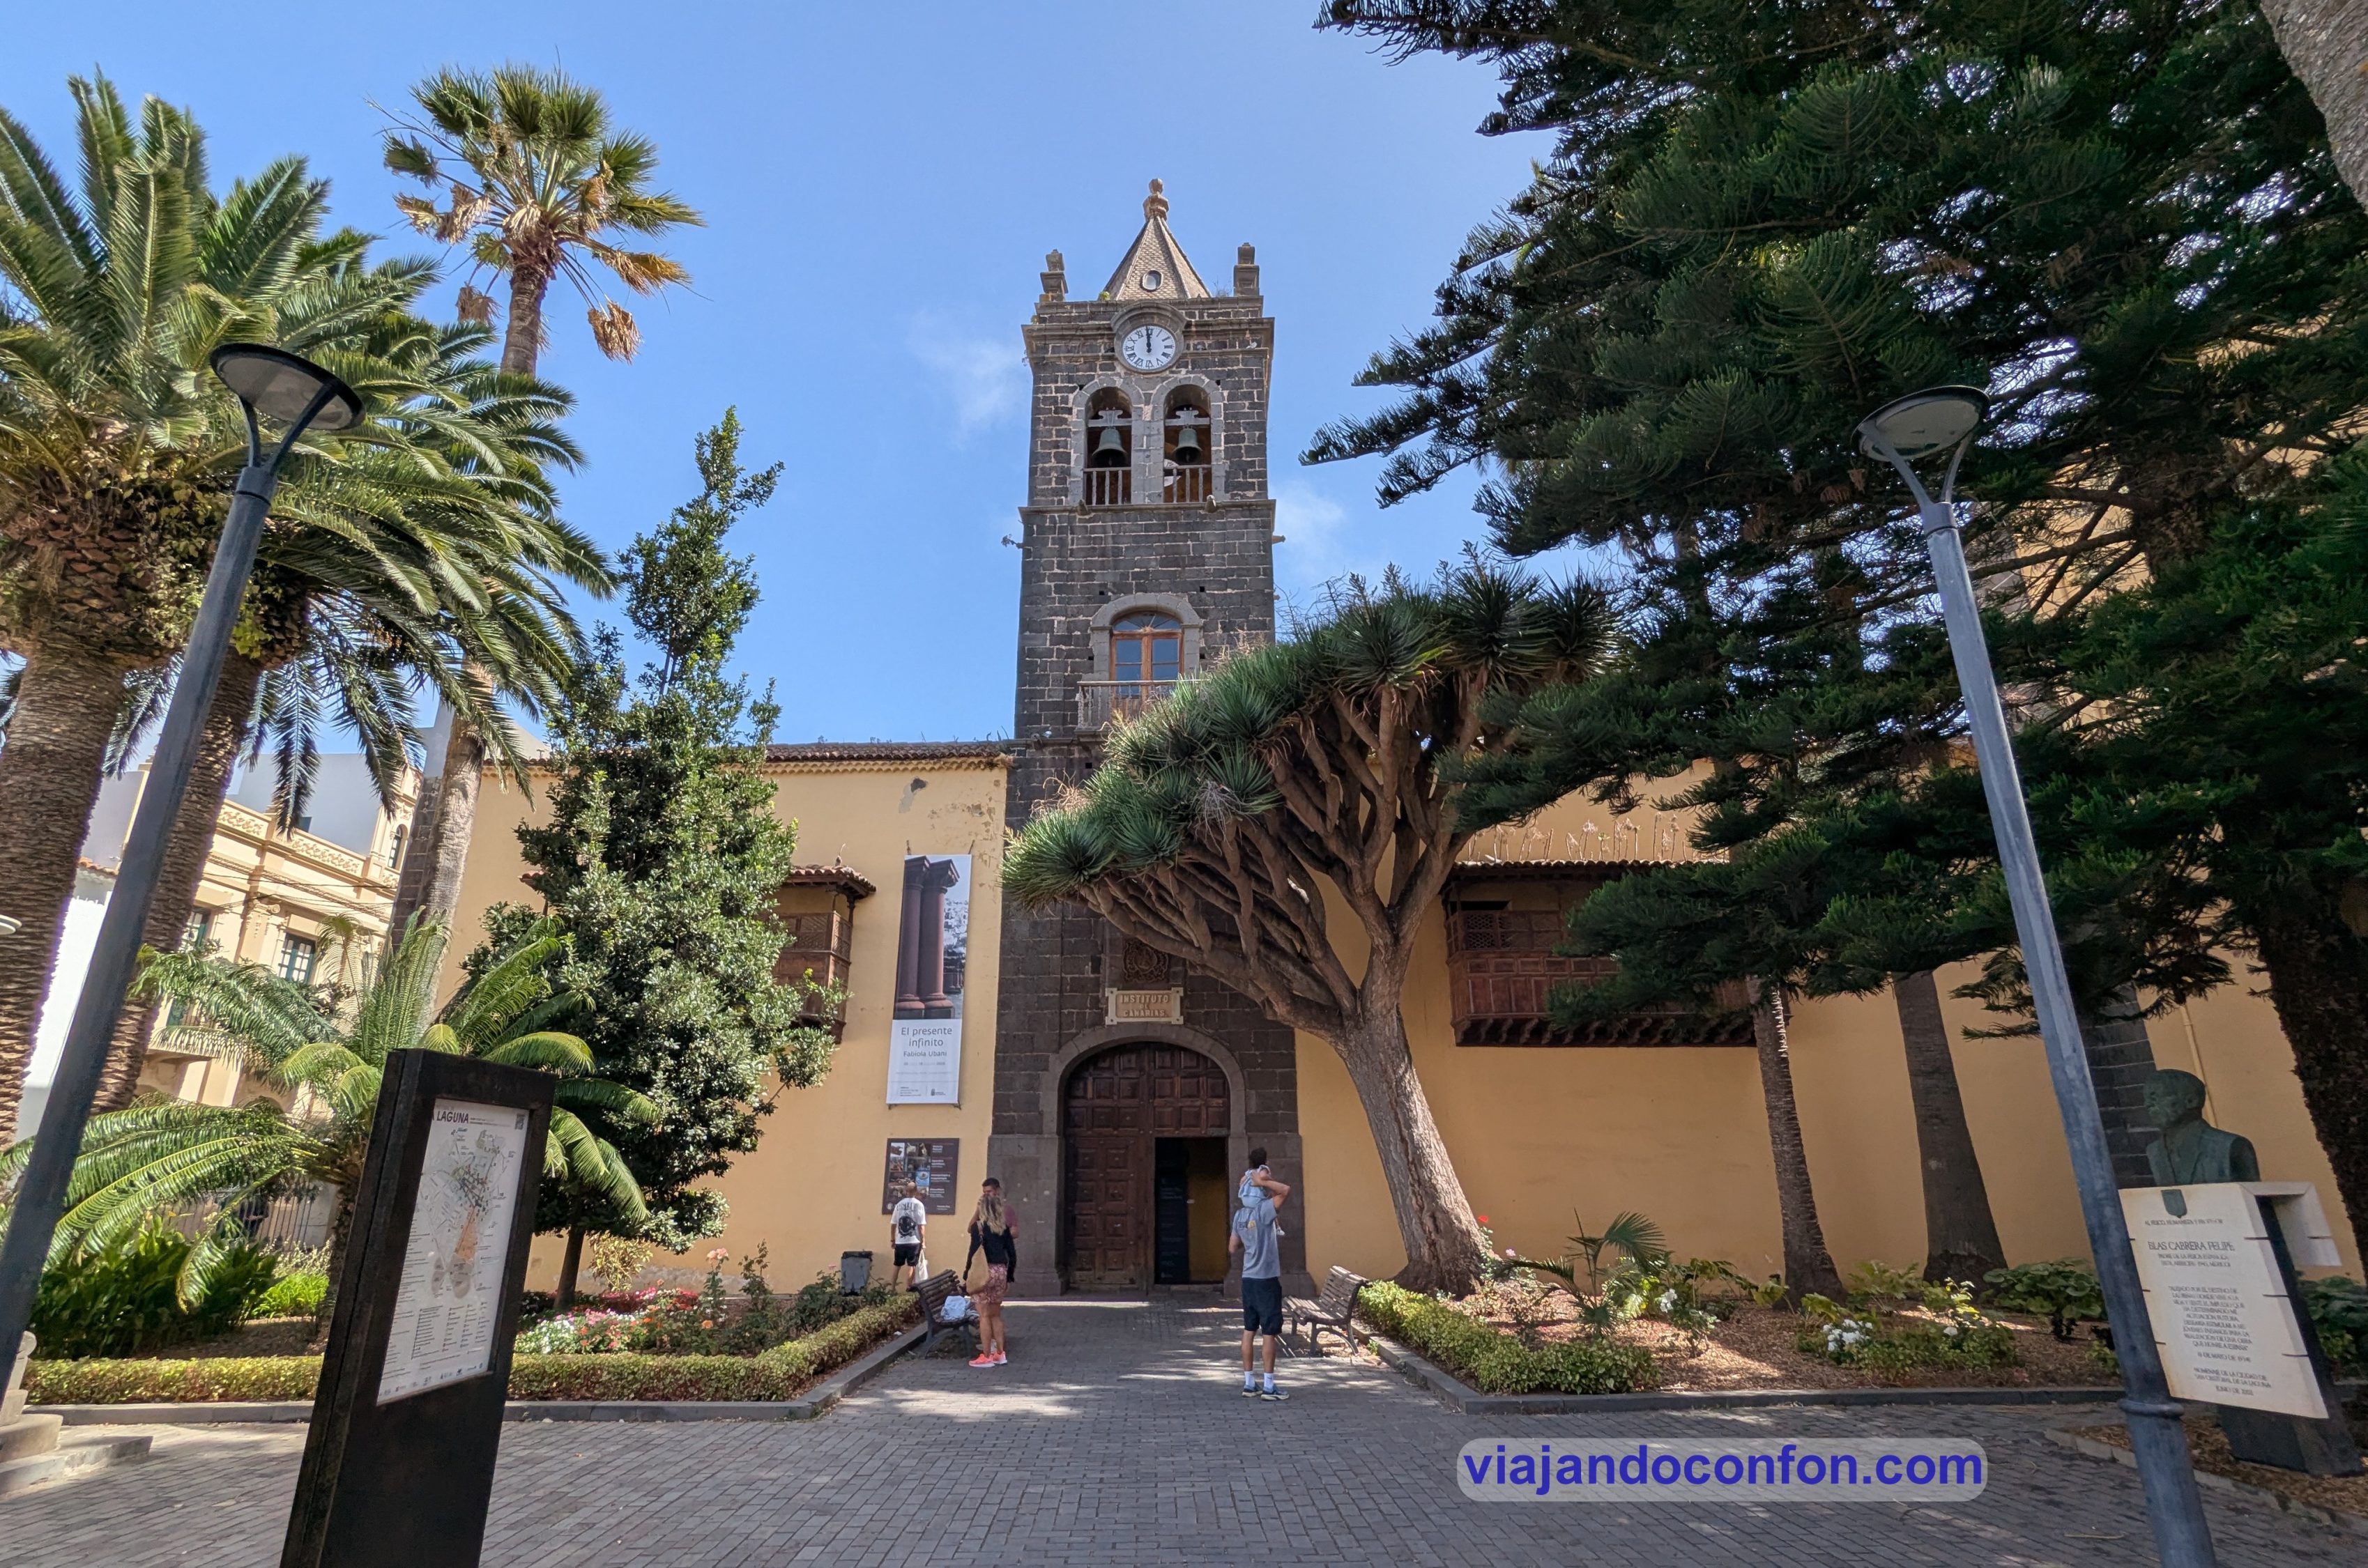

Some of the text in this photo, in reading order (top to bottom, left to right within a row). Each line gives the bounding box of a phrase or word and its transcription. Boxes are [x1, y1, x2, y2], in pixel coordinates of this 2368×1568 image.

[1120, 994, 1169, 1003] INSTITUTO
[901, 1027, 952, 1037] El presente
[909, 1038, 943, 1048] infinito
[436, 1111, 468, 1123] LAGUNA
[2147, 1241, 2235, 1252] BLAS CABRERA FELIPE
